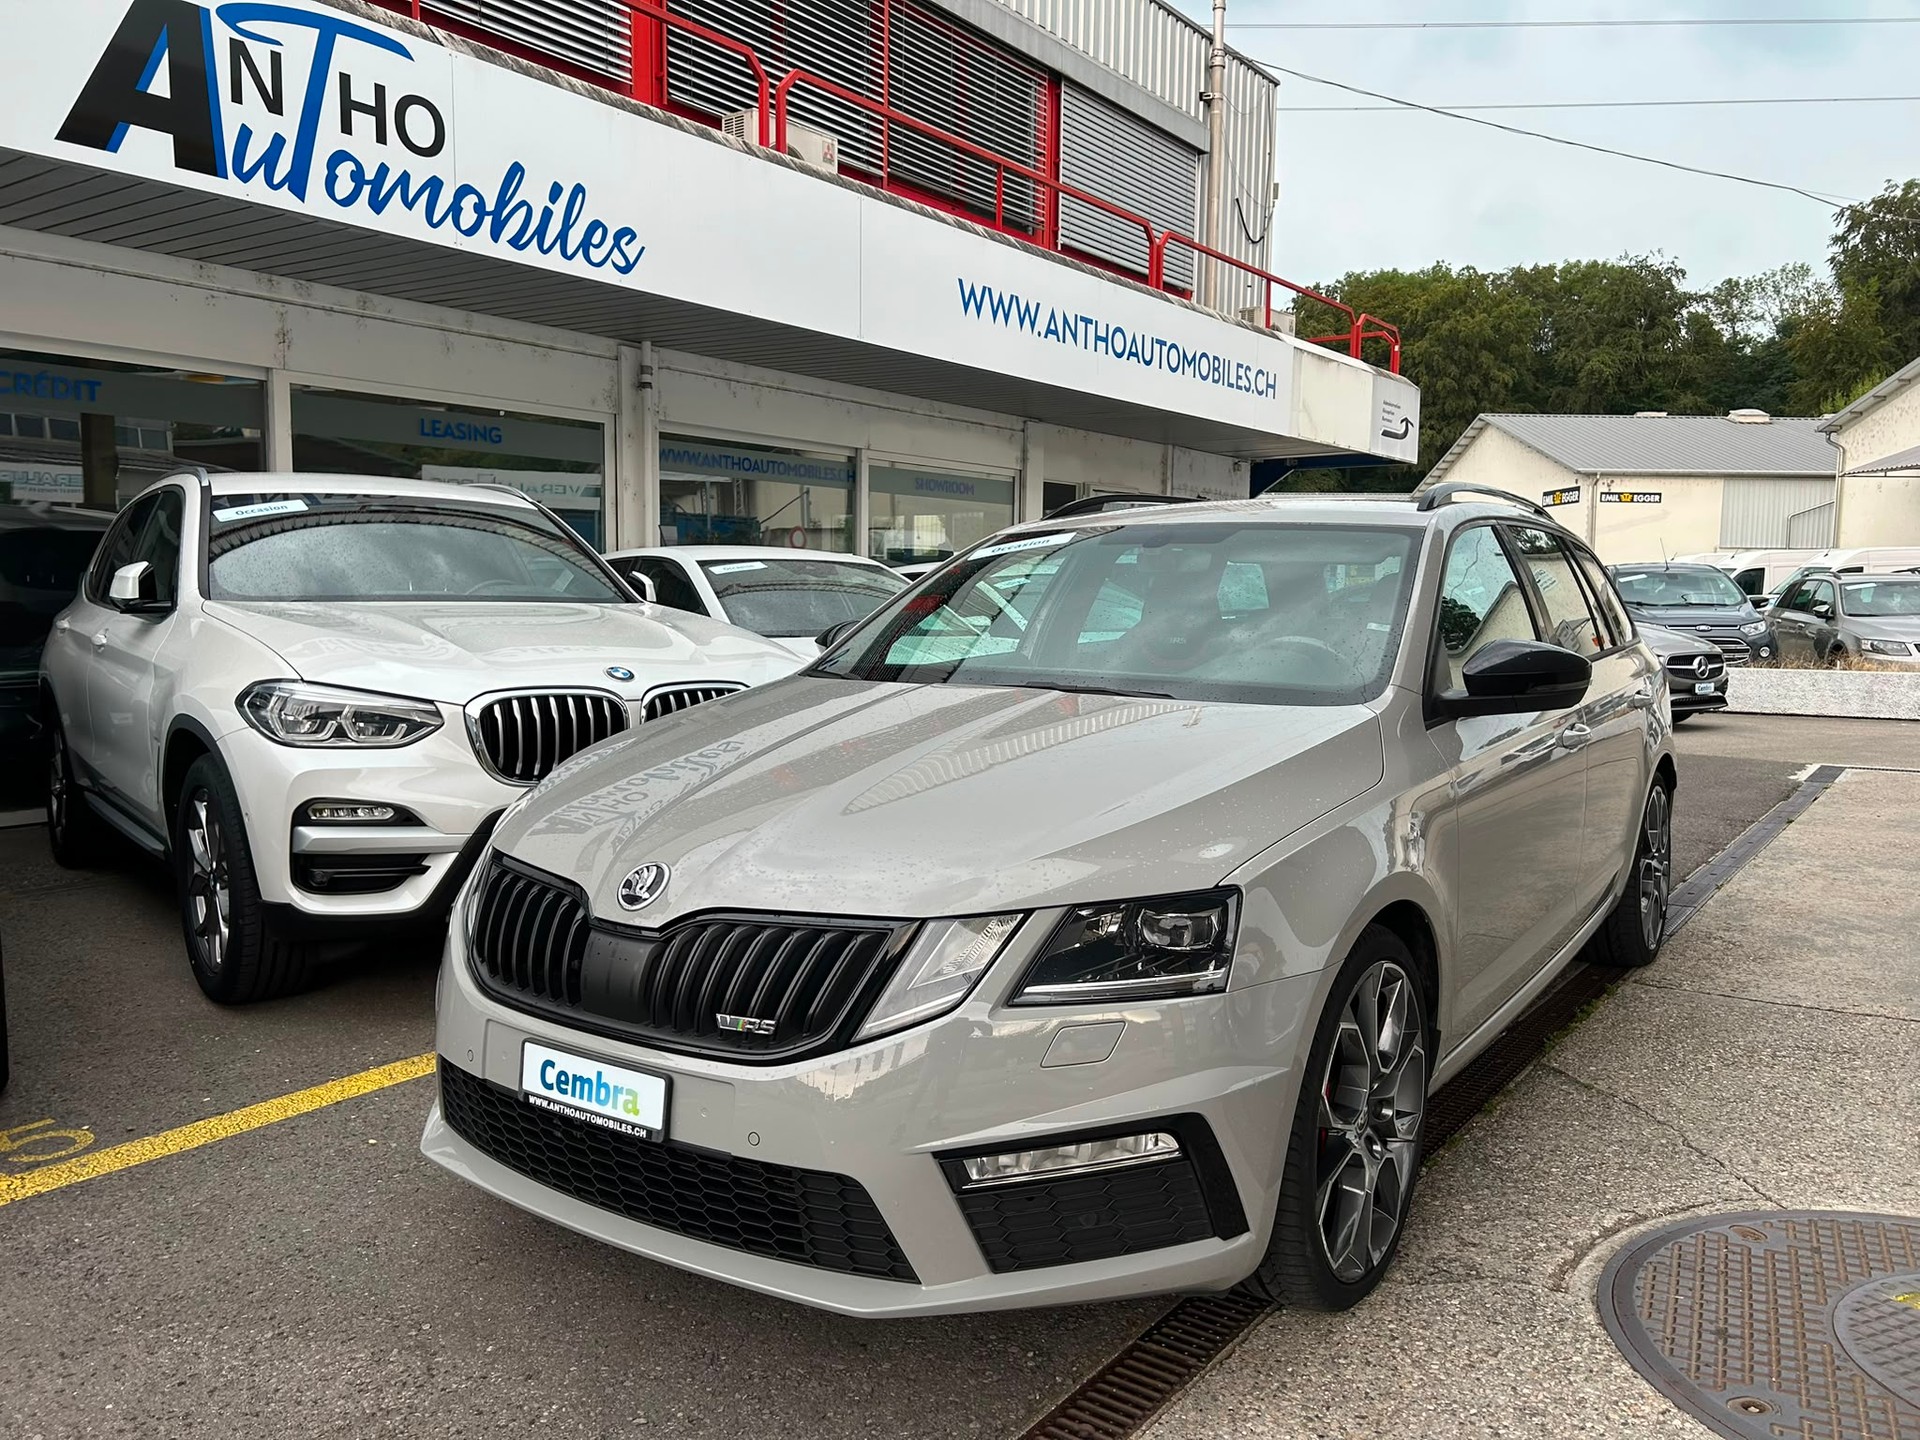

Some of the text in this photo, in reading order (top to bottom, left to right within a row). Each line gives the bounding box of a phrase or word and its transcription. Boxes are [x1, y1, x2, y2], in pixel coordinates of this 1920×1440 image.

[957, 278, 1277, 400] WWW.ANTHOAUTOMOBILES.CH
[420, 418, 502, 444] LEASING
[914, 477, 975, 496] SHOWROOM
[1601, 494, 1660, 503] EMIL EGGER
[235, 504, 288, 516] Occasion
[991, 539, 1051, 554] Occasion
[540, 1058, 640, 1117] Cembra
[528, 1094, 647, 1139] WWW.ANTHOAUTOMOBILES.CH
